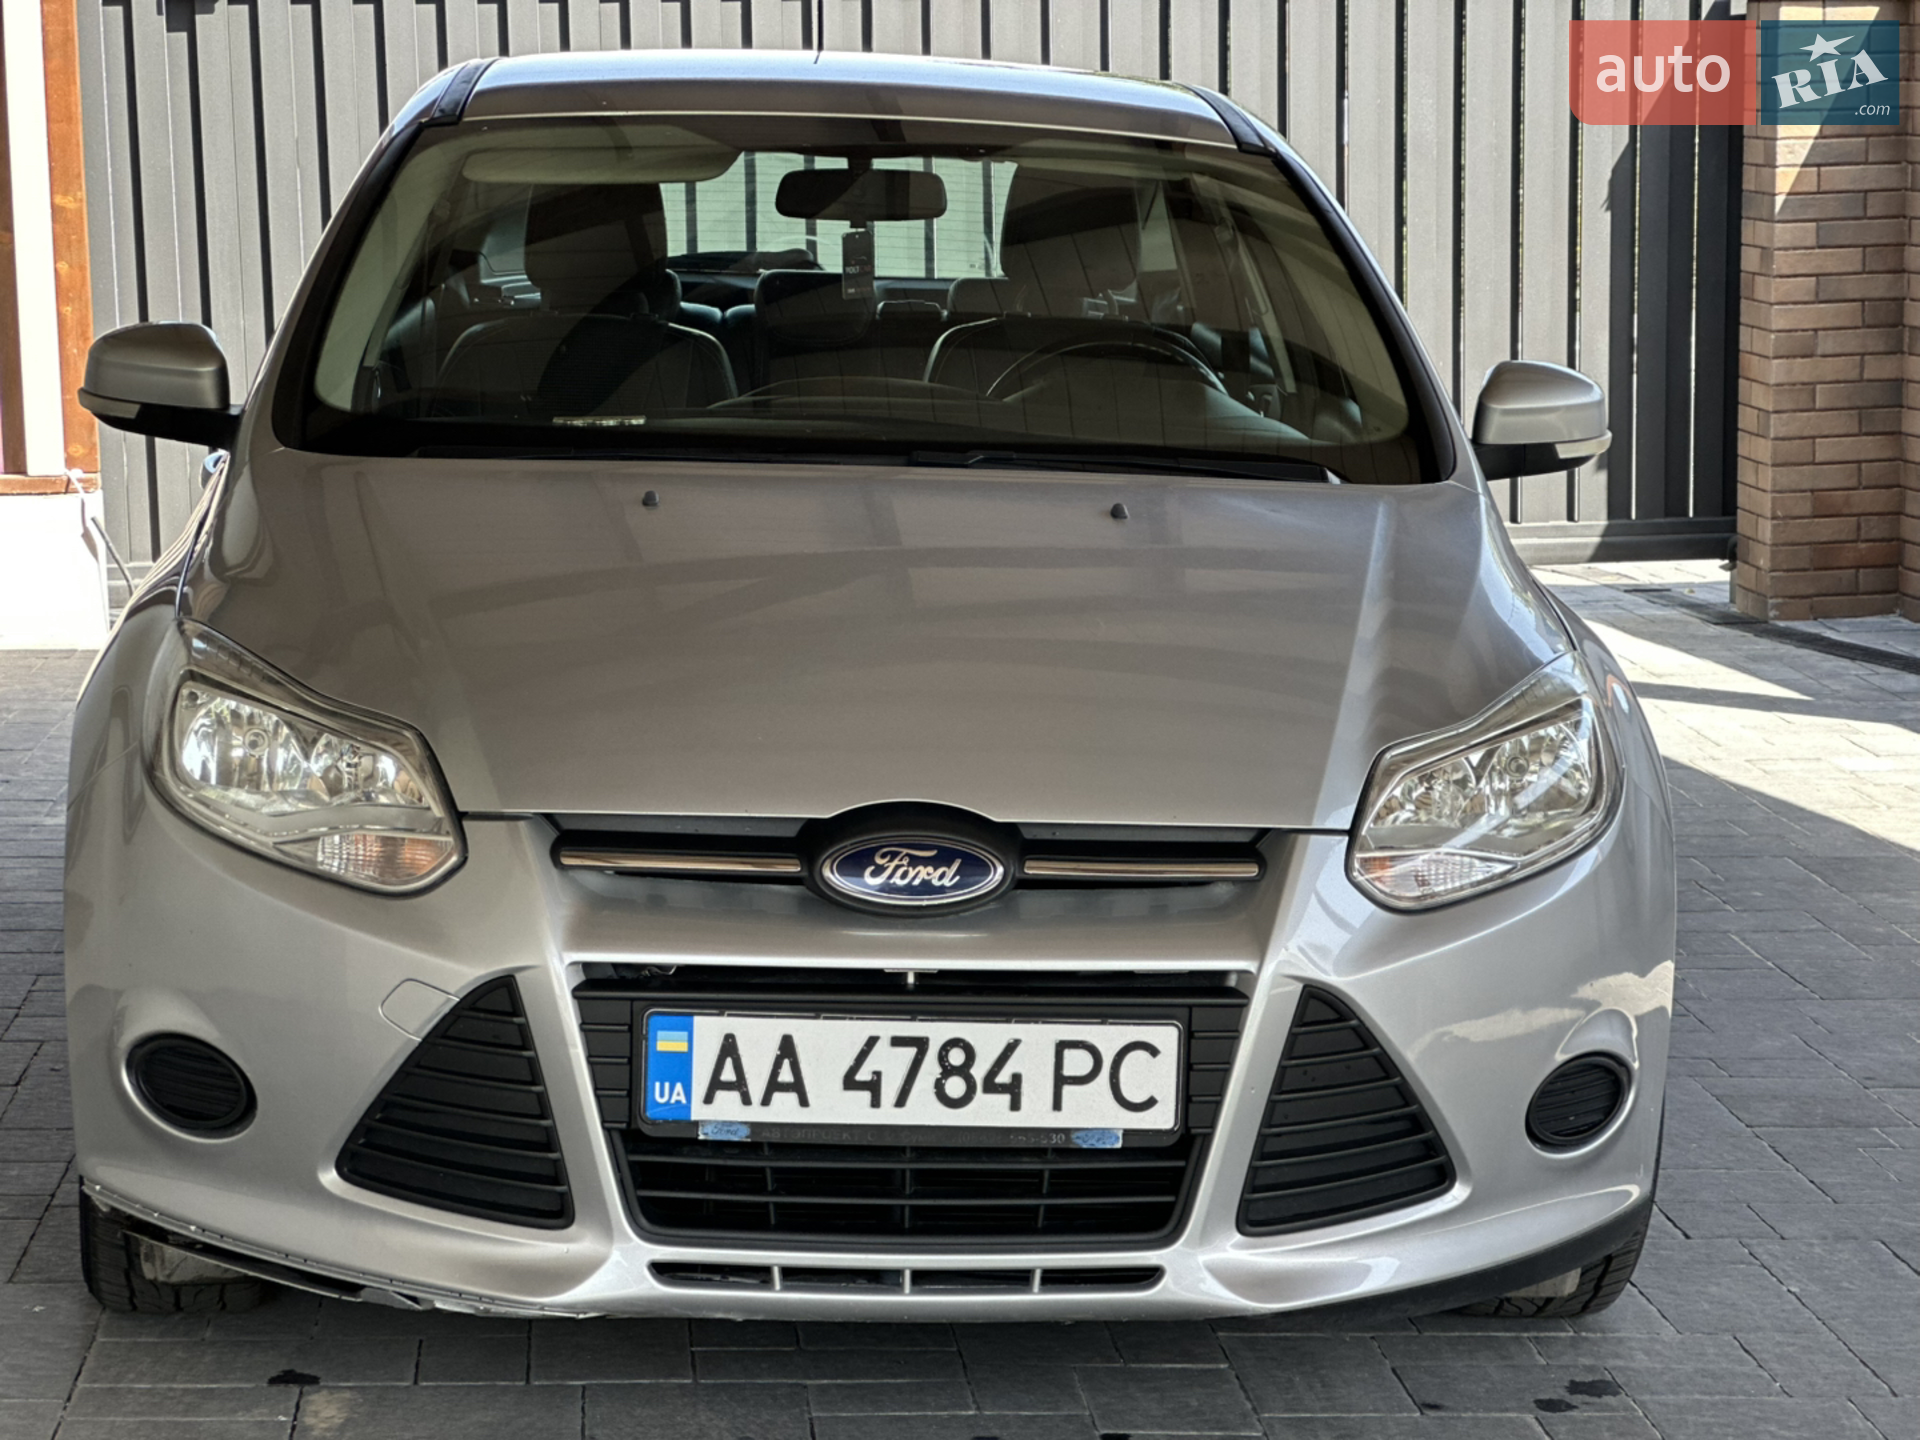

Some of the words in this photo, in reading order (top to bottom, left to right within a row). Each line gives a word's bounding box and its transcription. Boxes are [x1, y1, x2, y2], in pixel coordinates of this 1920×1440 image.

[863, 847, 962, 887] Ford
[702, 1032, 810, 1108] AA
[842, 1035, 1022, 1111] 4784
[1052, 1039, 1161, 1112] PC
[655, 1081, 687, 1105] UA
